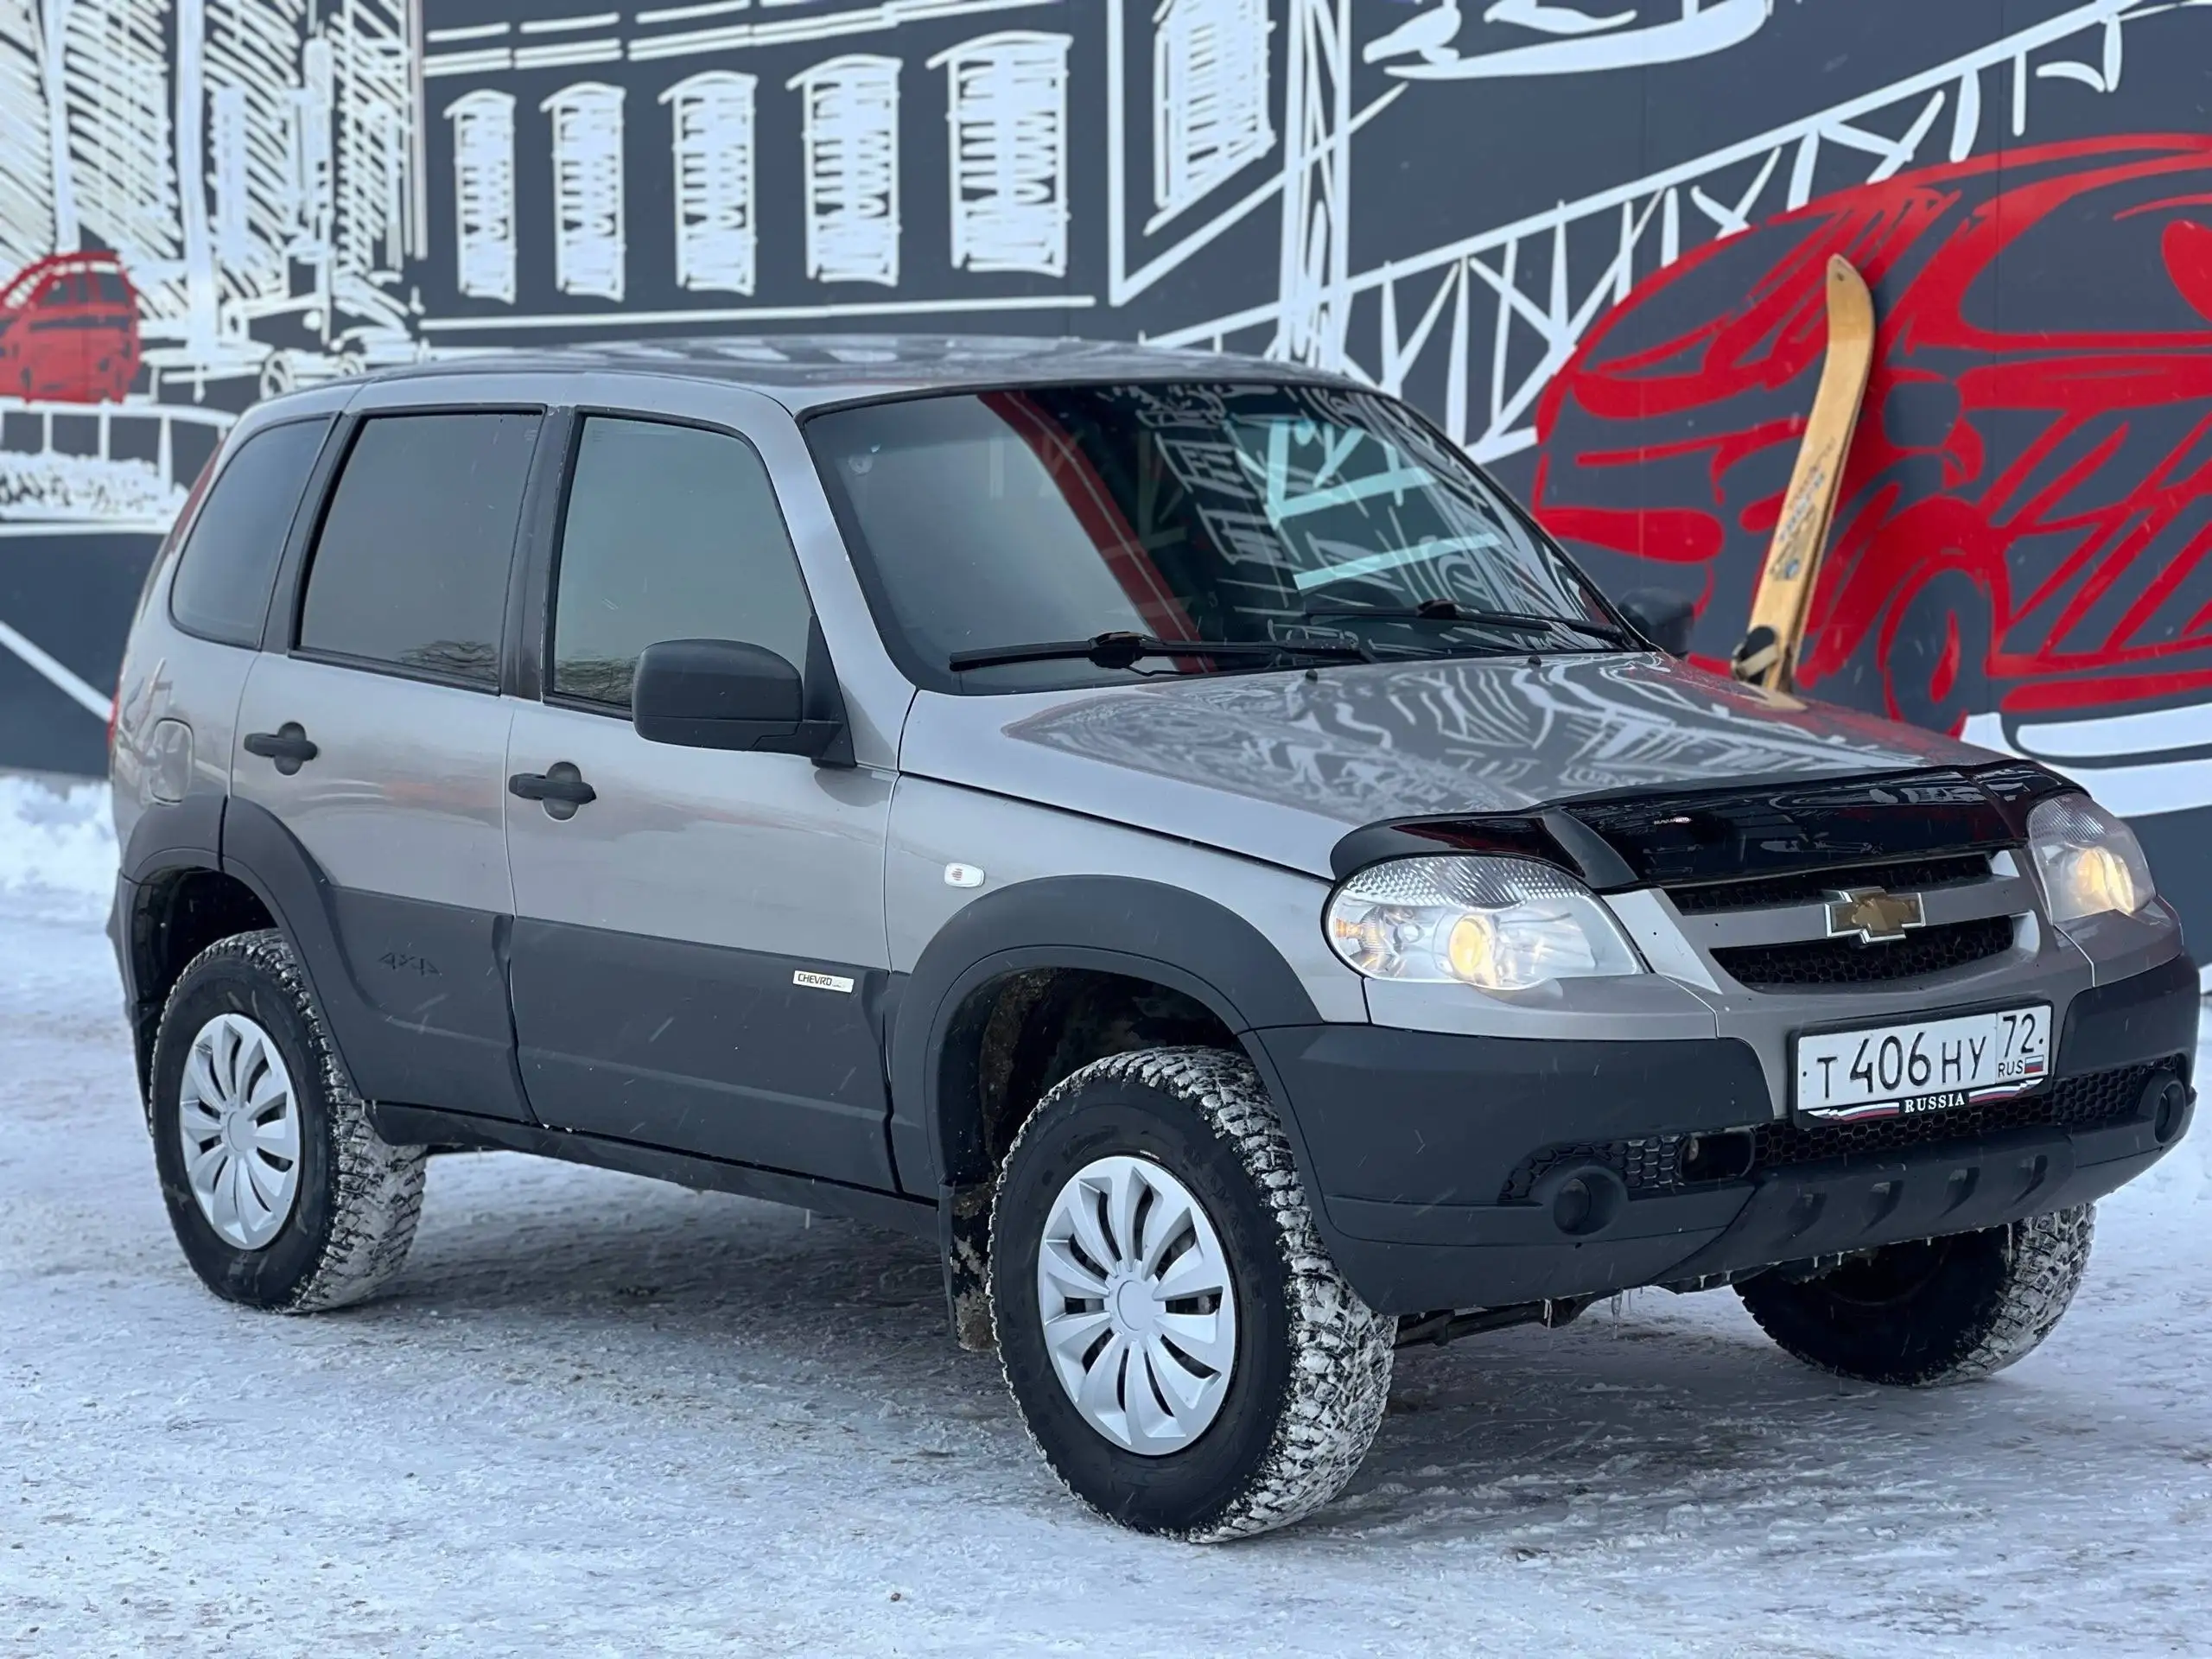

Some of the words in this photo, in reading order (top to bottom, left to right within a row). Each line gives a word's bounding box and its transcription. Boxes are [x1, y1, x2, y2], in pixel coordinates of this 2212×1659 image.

[798, 973, 842, 987] CHEVRO
[2002, 1014, 2035, 1058] 72
[1998, 1060, 2024, 1078] RUS
[1904, 1092, 1966, 1113] RUSSIA
